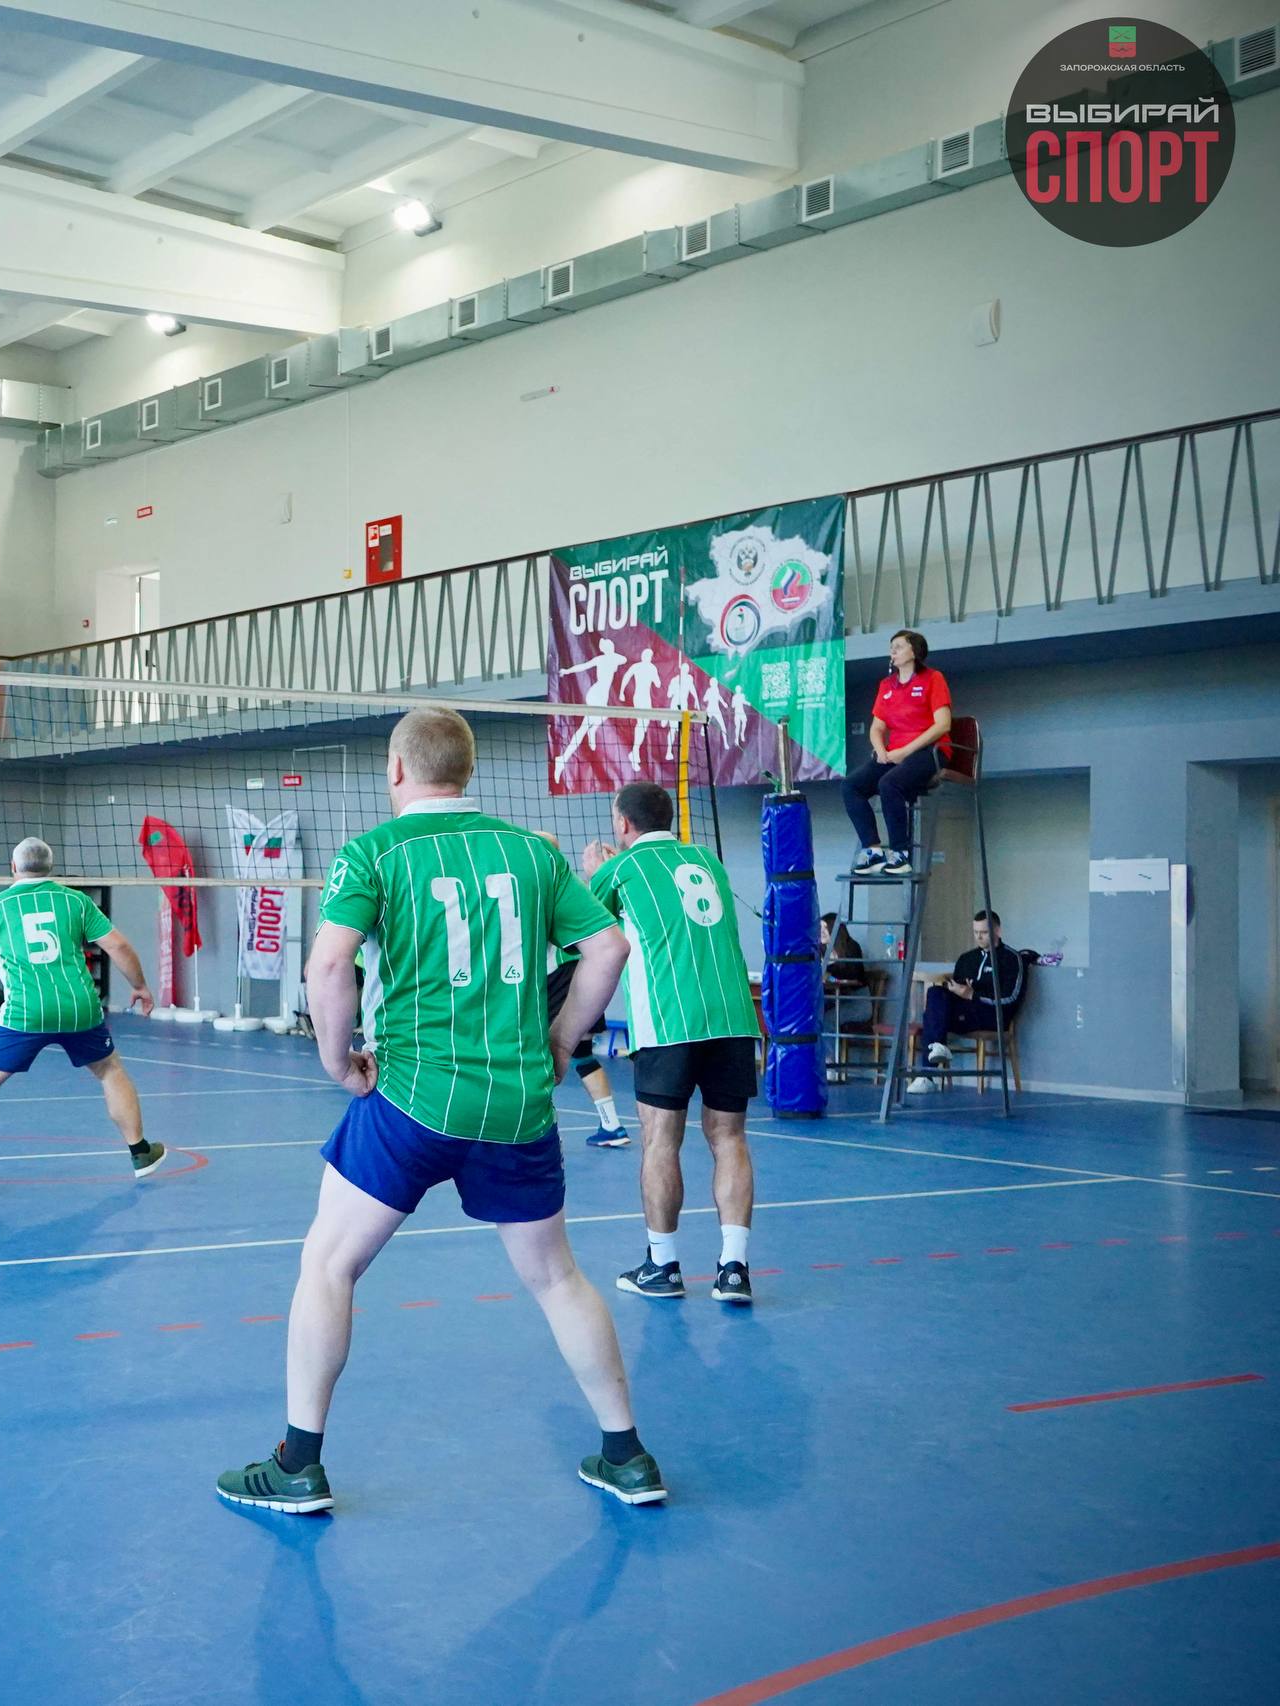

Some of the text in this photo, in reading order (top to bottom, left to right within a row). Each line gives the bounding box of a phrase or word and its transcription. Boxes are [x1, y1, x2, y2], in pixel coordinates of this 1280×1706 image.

[568, 545, 670, 581] ВЫБИРАЙ
[568, 569, 670, 636] СПОРТ
[255, 886, 285, 953] СПОРТ
[674, 863, 724, 928] 8
[21, 911, 61, 965] 5
[430, 872, 525, 988] 11
